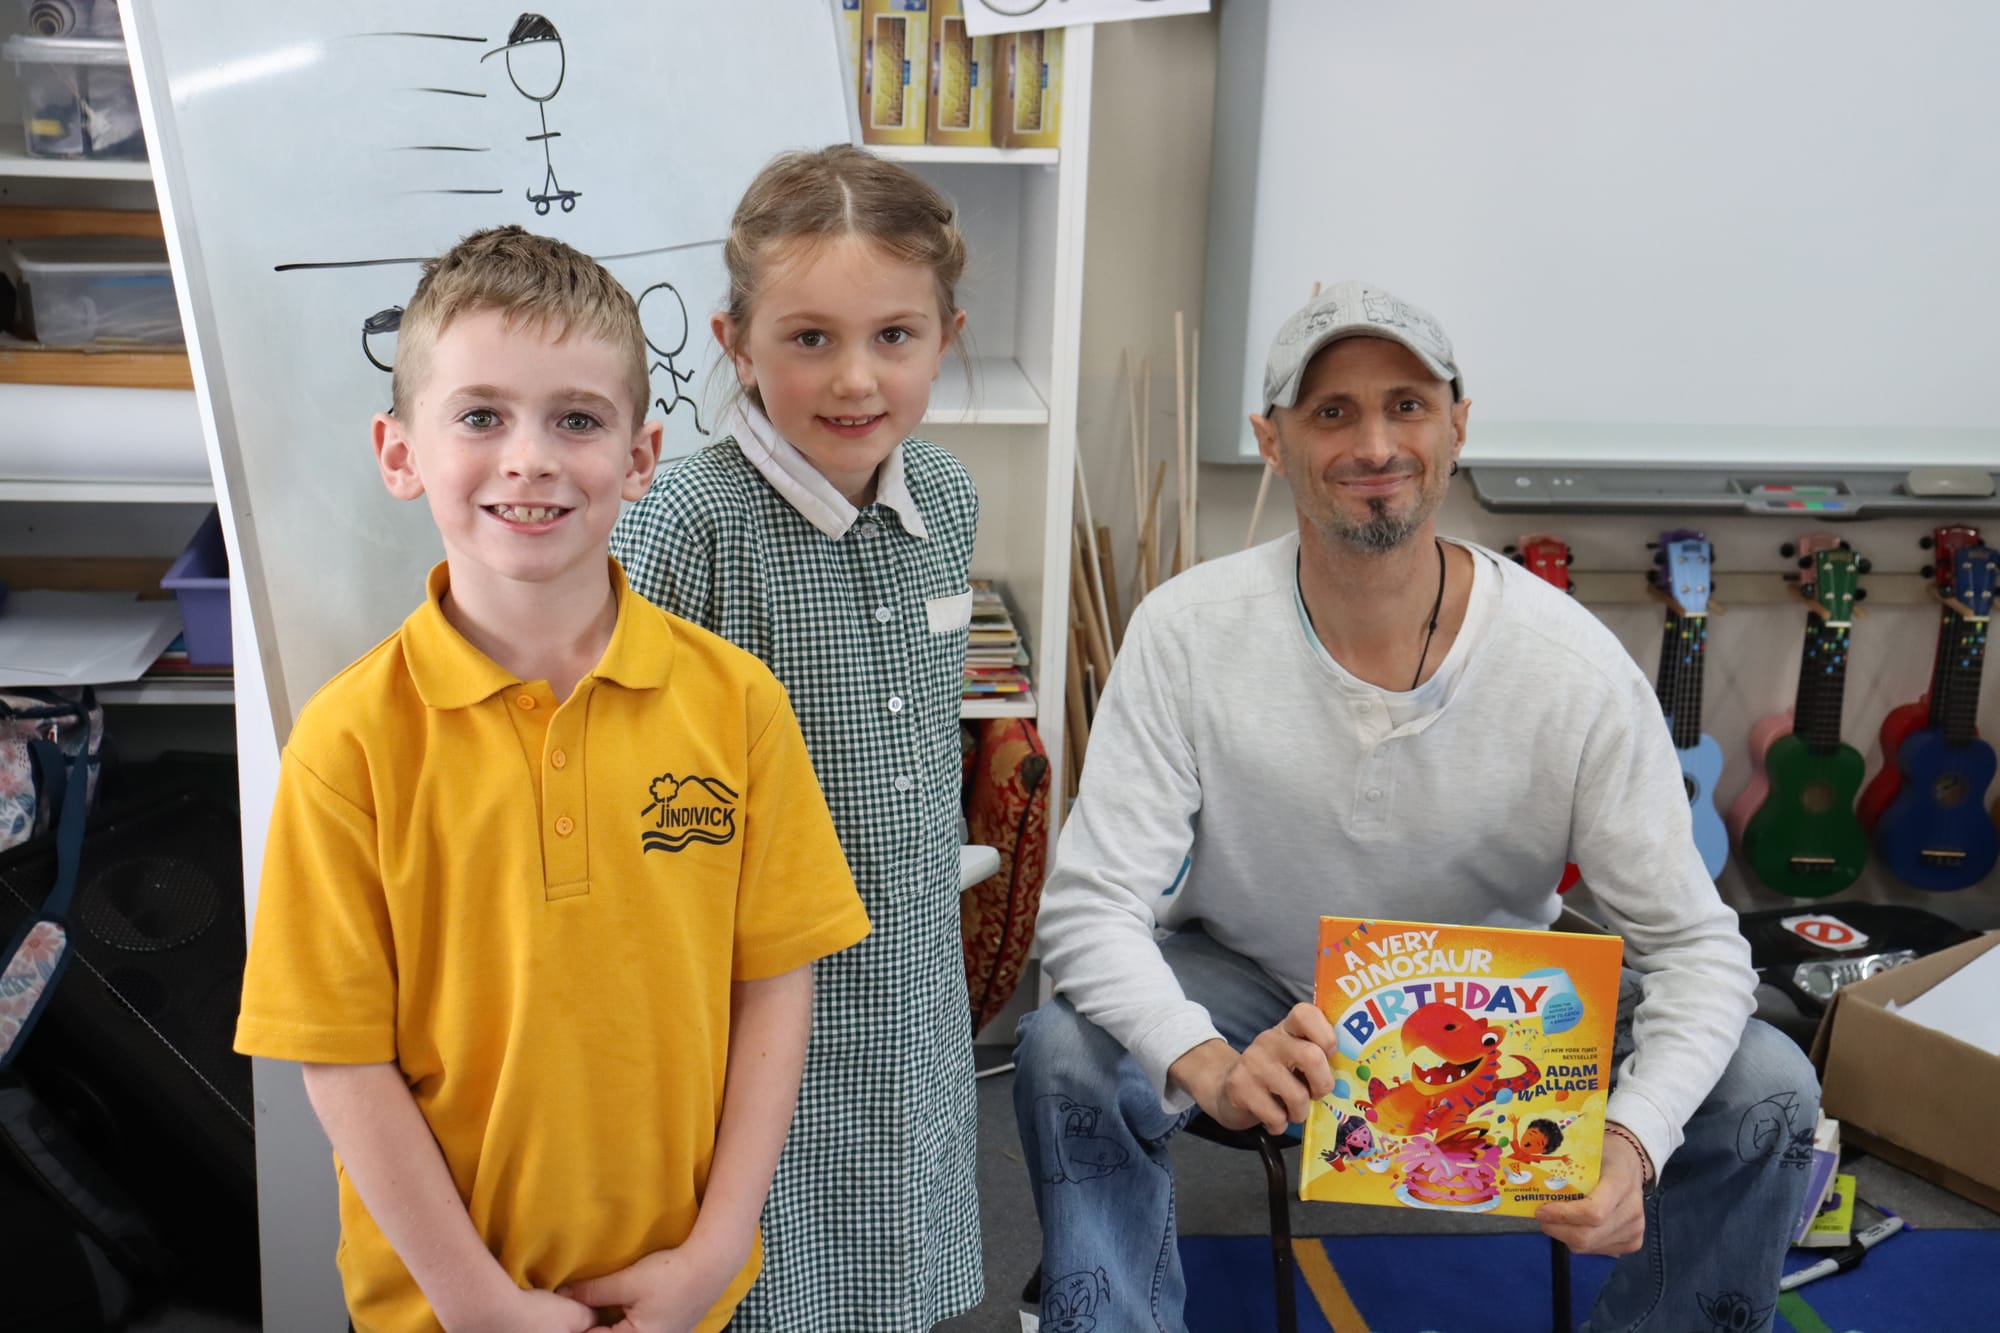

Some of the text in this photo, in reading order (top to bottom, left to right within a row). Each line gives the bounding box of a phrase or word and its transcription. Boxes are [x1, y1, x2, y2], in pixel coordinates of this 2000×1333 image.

[1344, 930, 1439, 972] A VERY
[1336, 948, 1493, 999] DINOSAUR
[1342, 981, 1549, 1045] BIRTHDAY
[1546, 1064, 1598, 1077] ADAM
[1518, 1078, 1598, 1102] WALLACE
[1514, 1192, 1585, 1202] CHRISTOPHER
